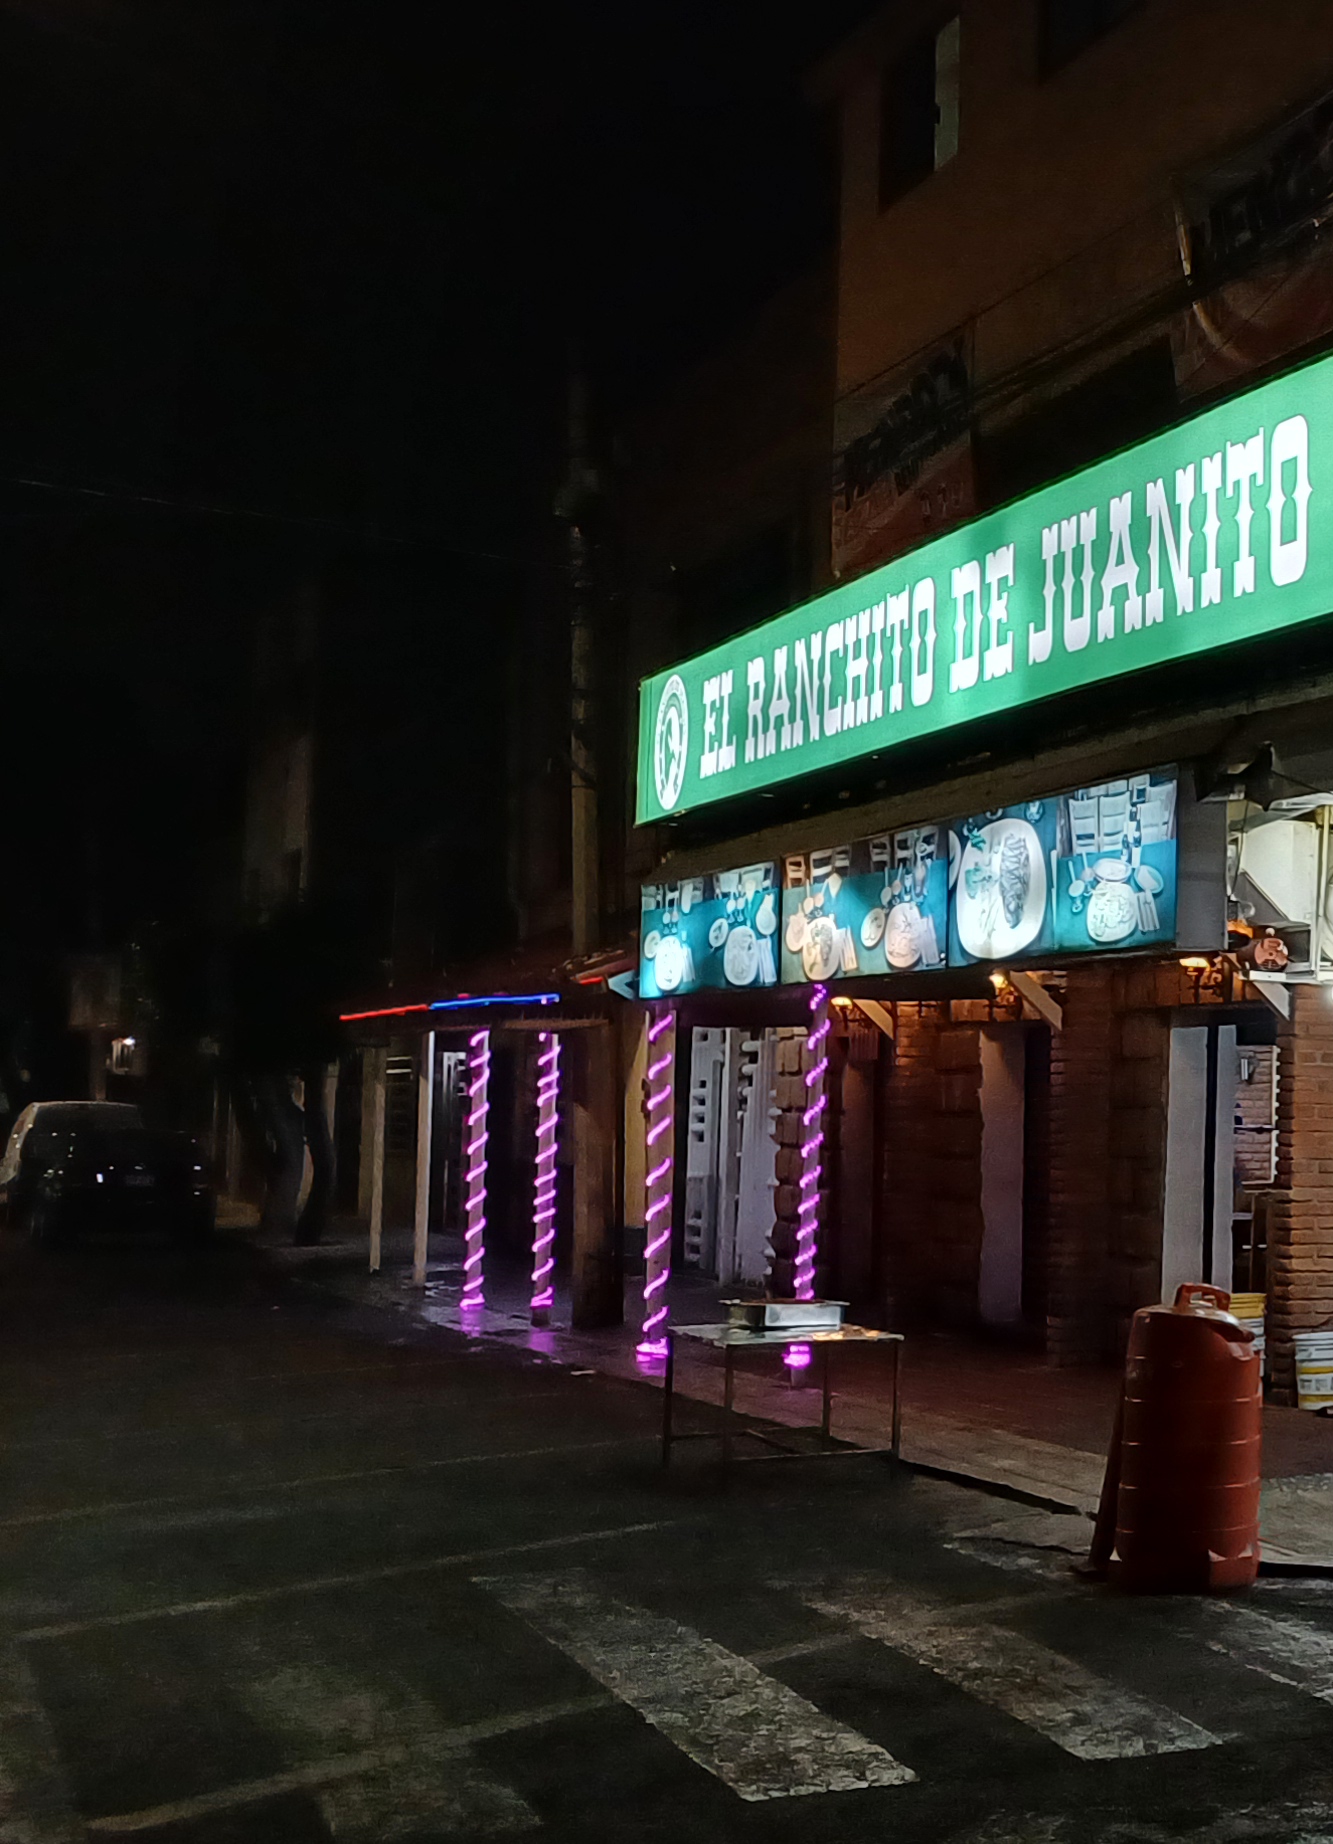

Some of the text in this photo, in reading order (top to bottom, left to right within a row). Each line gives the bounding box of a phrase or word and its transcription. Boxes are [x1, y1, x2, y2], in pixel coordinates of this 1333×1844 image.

[700, 669, 736, 779] EL
[744, 575, 937, 763] RANCHITO
[949, 542, 1015, 693] DE
[1028, 414, 1312, 666] JUANITO
